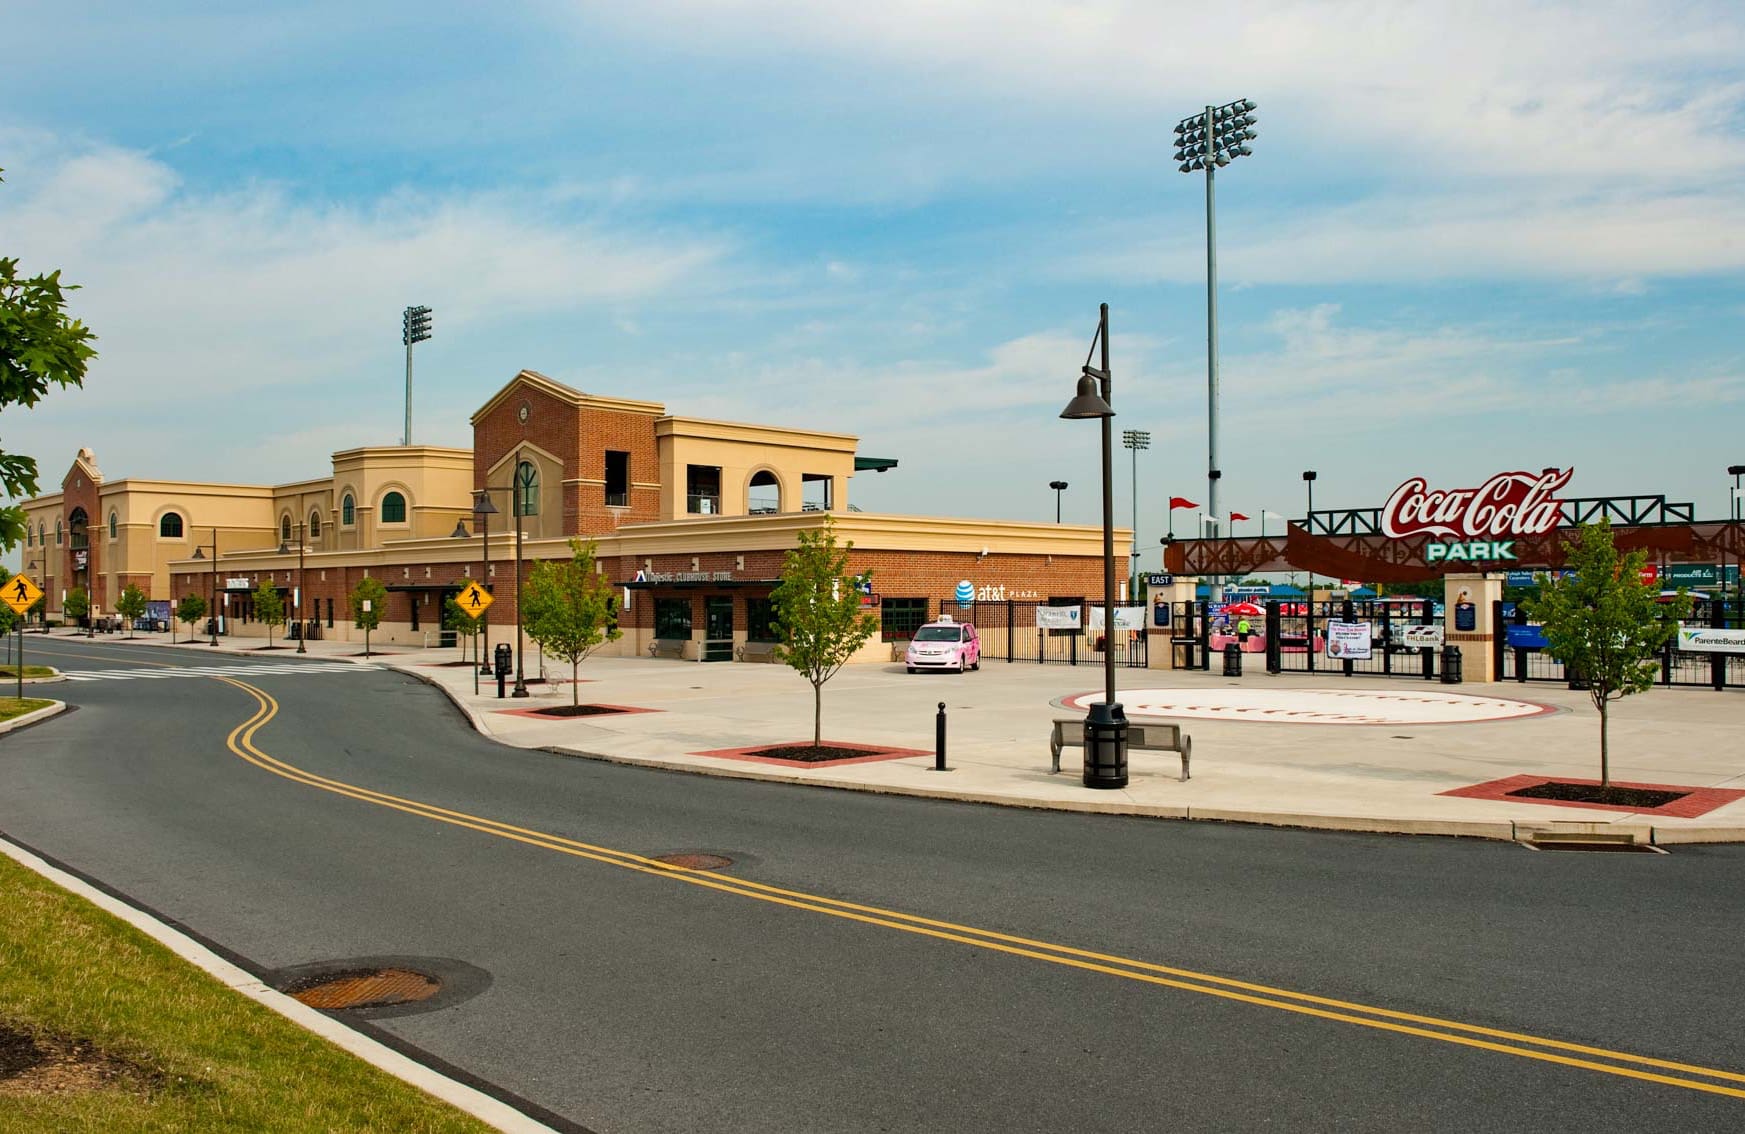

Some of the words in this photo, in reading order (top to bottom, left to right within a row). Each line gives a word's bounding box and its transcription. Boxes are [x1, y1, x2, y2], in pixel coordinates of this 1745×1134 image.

[1427, 541, 1517, 561] PARK
[713, 571, 732, 582] STORE
[1151, 576, 1169, 584] EAST
[978, 584, 1005, 601] at&t
[1694, 637, 1745, 646] ParenteBeard
